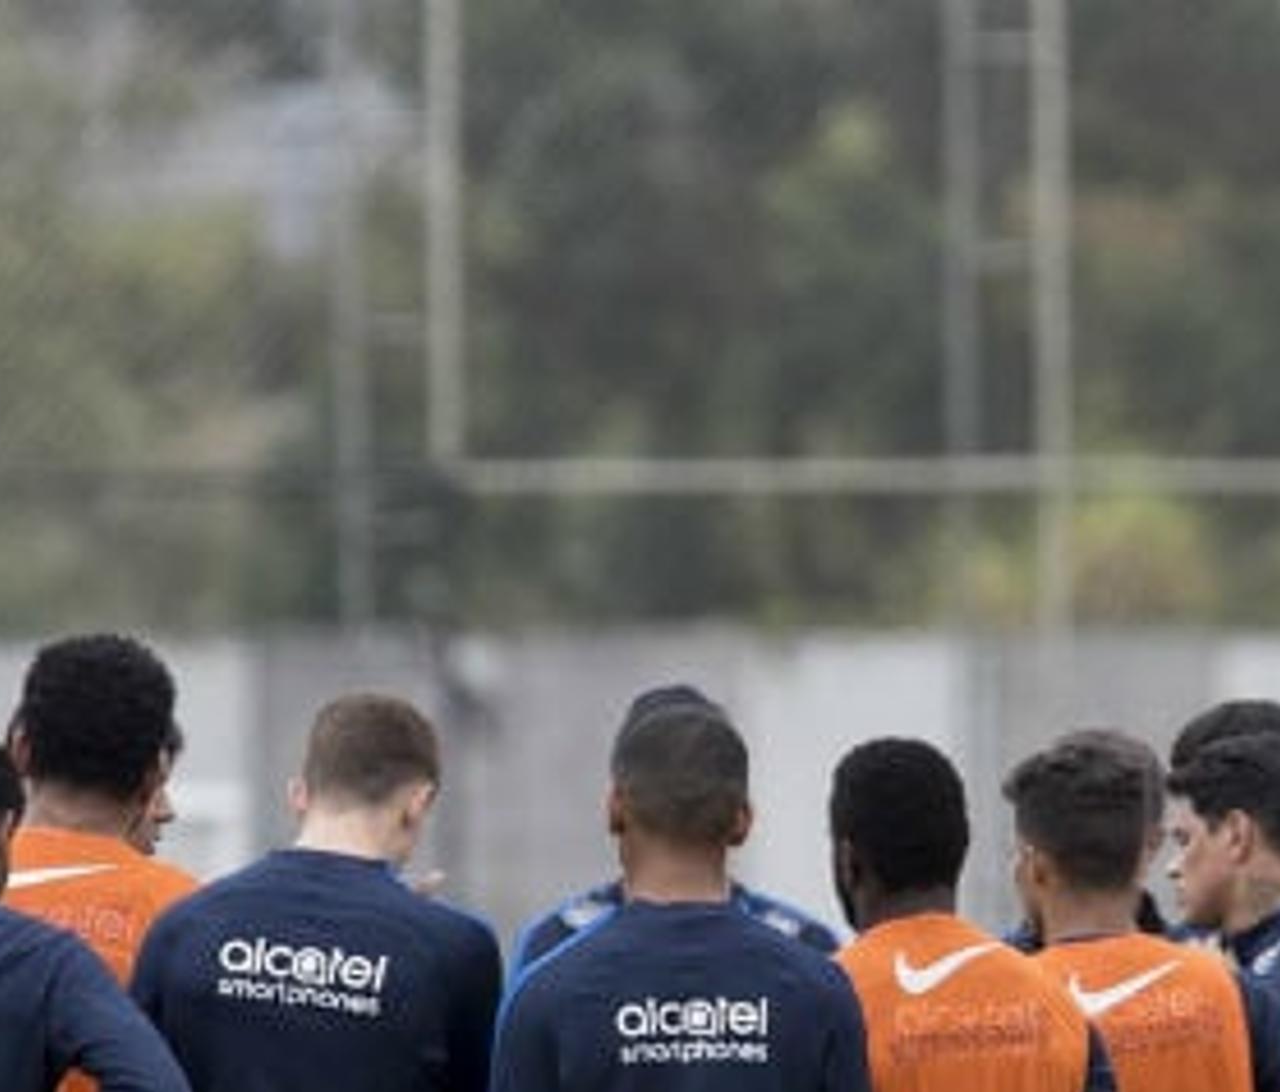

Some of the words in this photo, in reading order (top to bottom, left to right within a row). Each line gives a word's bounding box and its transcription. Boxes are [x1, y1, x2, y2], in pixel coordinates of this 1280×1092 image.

[219, 936, 389, 993] alcatel
[218, 977, 382, 1017] smartphones
[616, 996, 769, 1037] alcatel
[621, 1038, 769, 1066] smartphones
